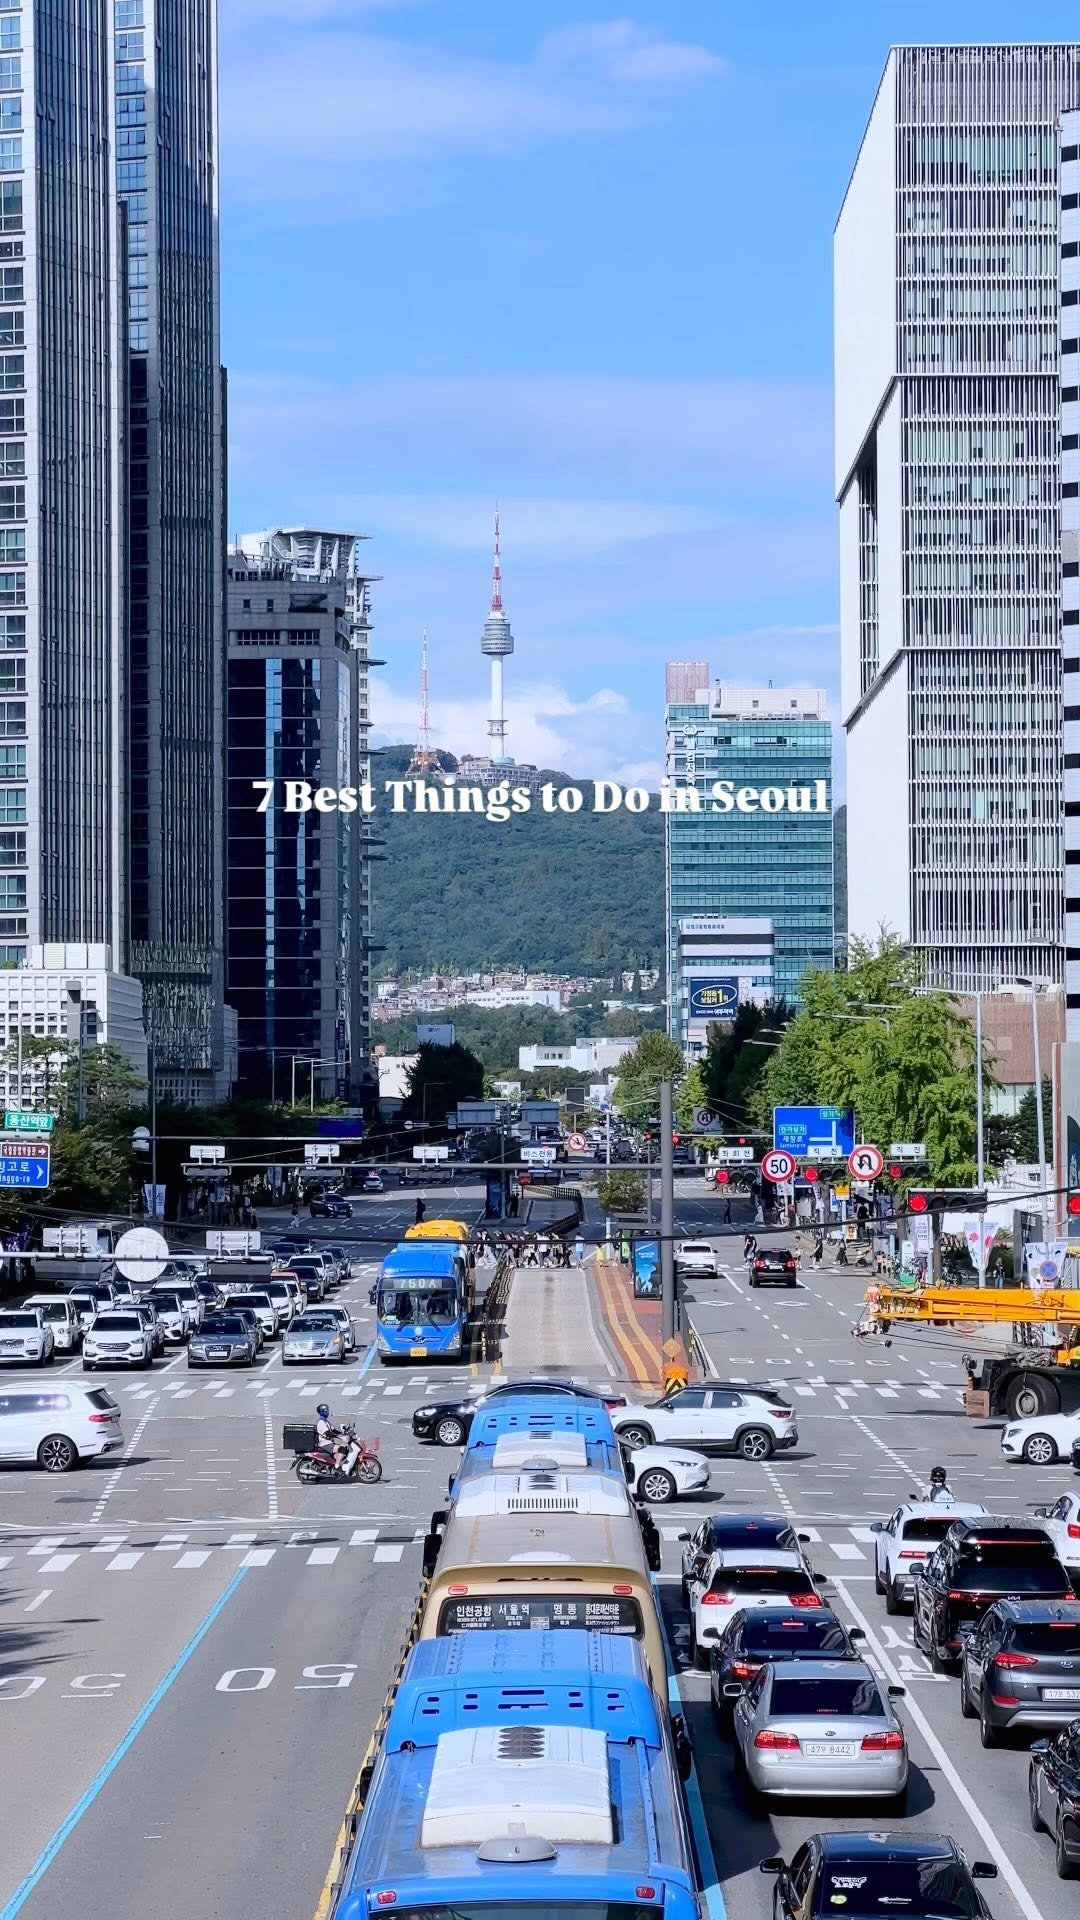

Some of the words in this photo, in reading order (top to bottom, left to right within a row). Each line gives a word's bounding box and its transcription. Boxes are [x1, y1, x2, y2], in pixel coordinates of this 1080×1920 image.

[8, 1114, 49, 1127] 용산역앞
[780, 1125, 805, 1134] 전자상가
[770, 1158, 788, 1174] 50
[456, 1605, 492, 1617] 인천공항
[829, 1745, 851, 1754] 8442
